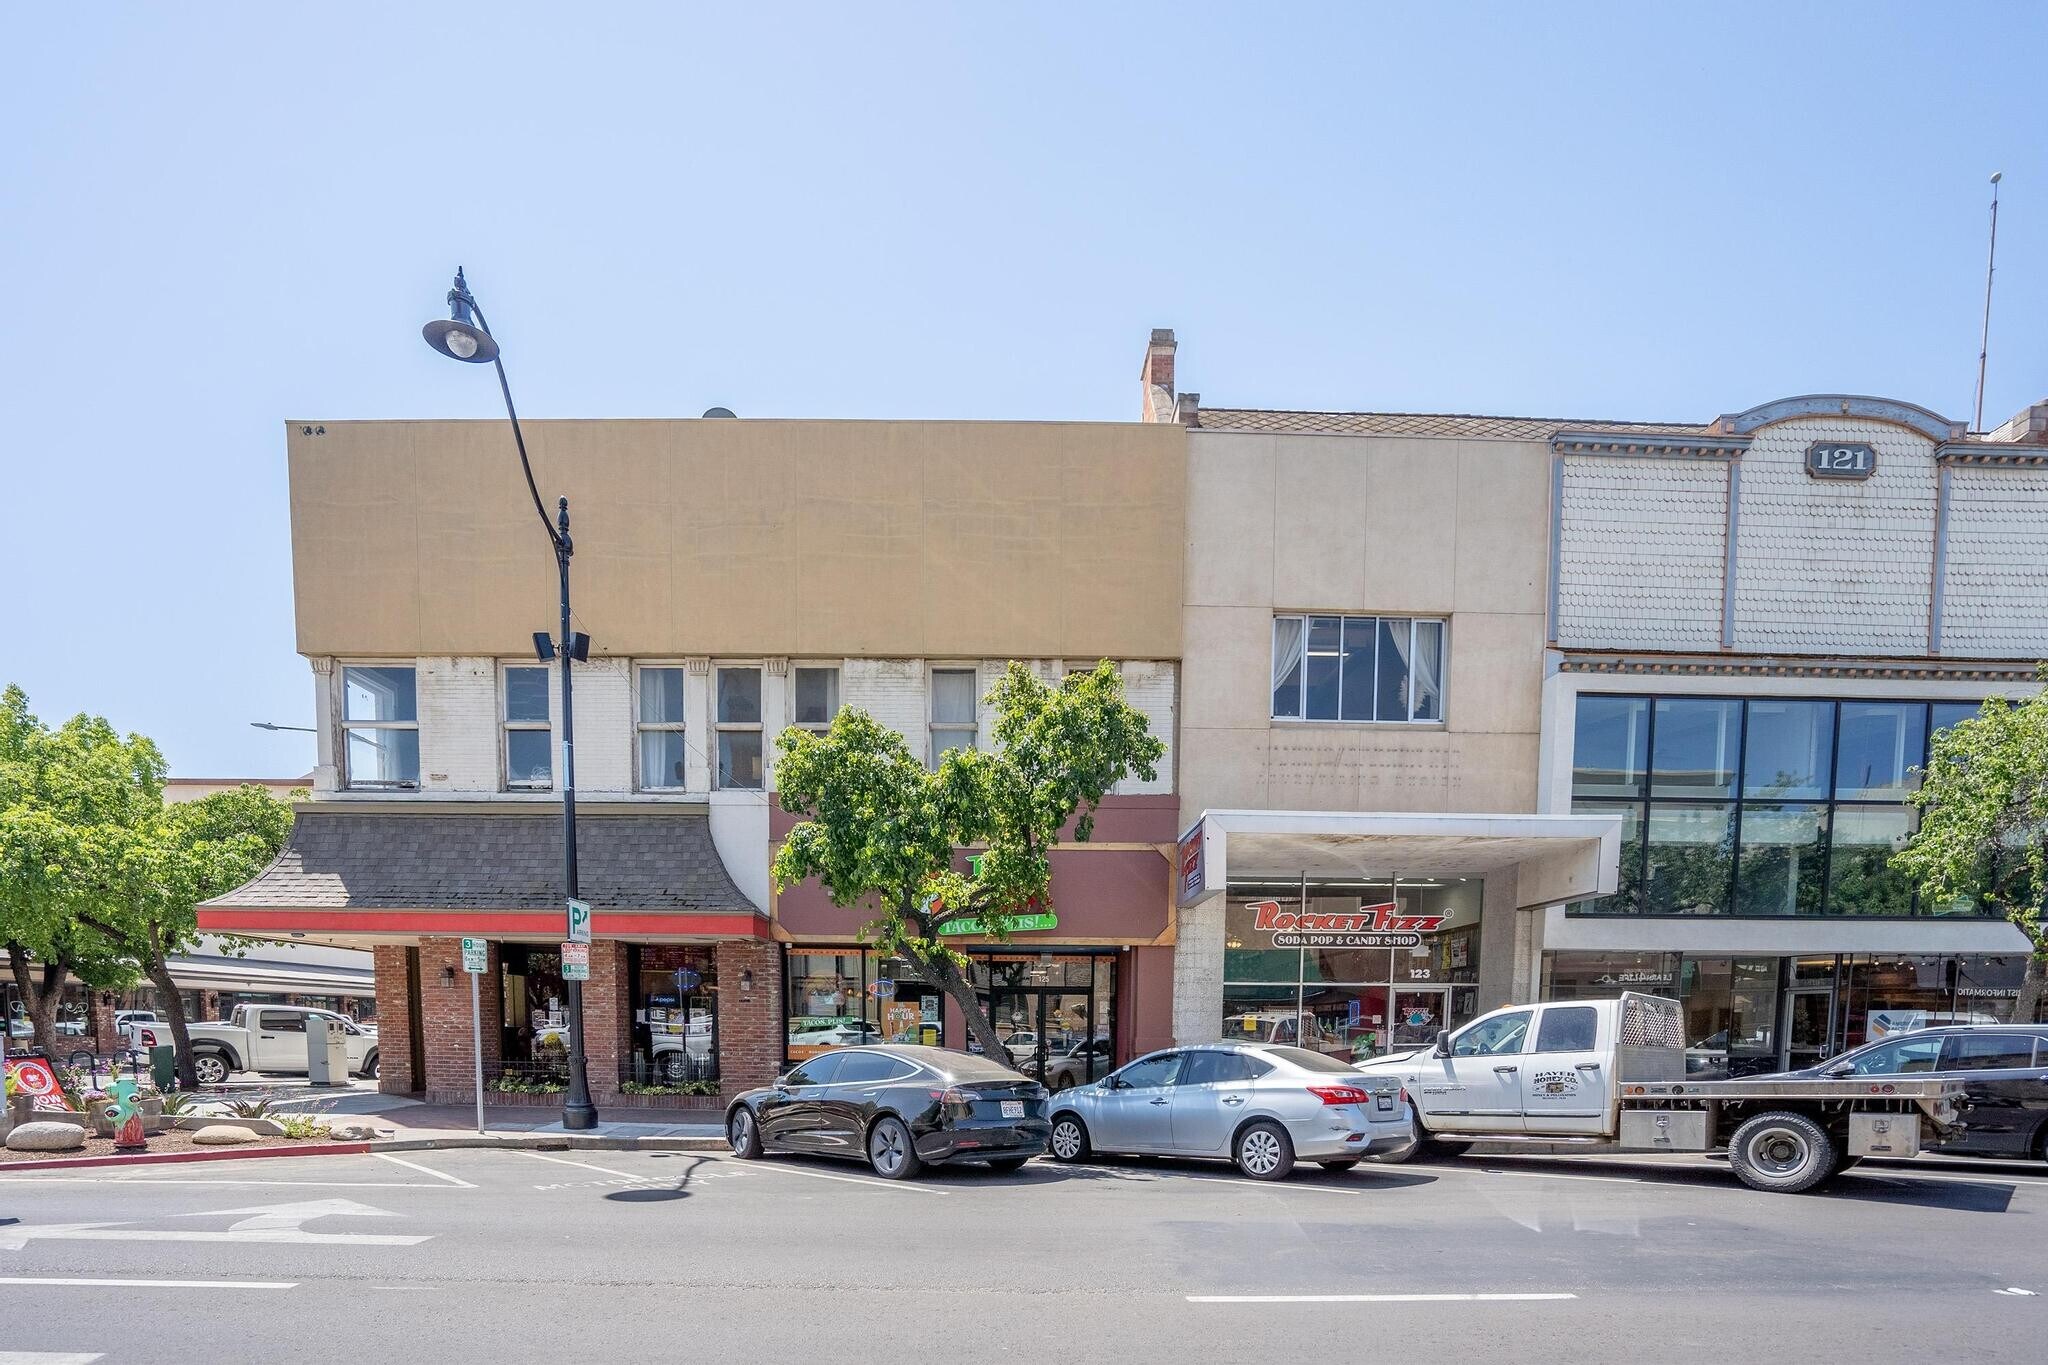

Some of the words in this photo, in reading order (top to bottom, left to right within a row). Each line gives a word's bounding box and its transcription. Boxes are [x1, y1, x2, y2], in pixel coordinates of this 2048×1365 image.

[1818, 448, 1867, 470] 121
[1245, 900, 1370, 931] ROCKET
[1360, 902, 1447, 932] FIZZ
[465, 940, 471, 948] 3
[1277, 936, 1307, 945] SODA
[1310, 936, 1333, 945] POP
[1336, 936, 1344, 945] &
[1345, 936, 1383, 945] CANDY
[1384, 936, 1417, 945] SHOP
[1410, 969, 1431, 979] 123
[887, 1012, 915, 1021] HOUR
[1533, 1076, 1564, 1084] HONEY
